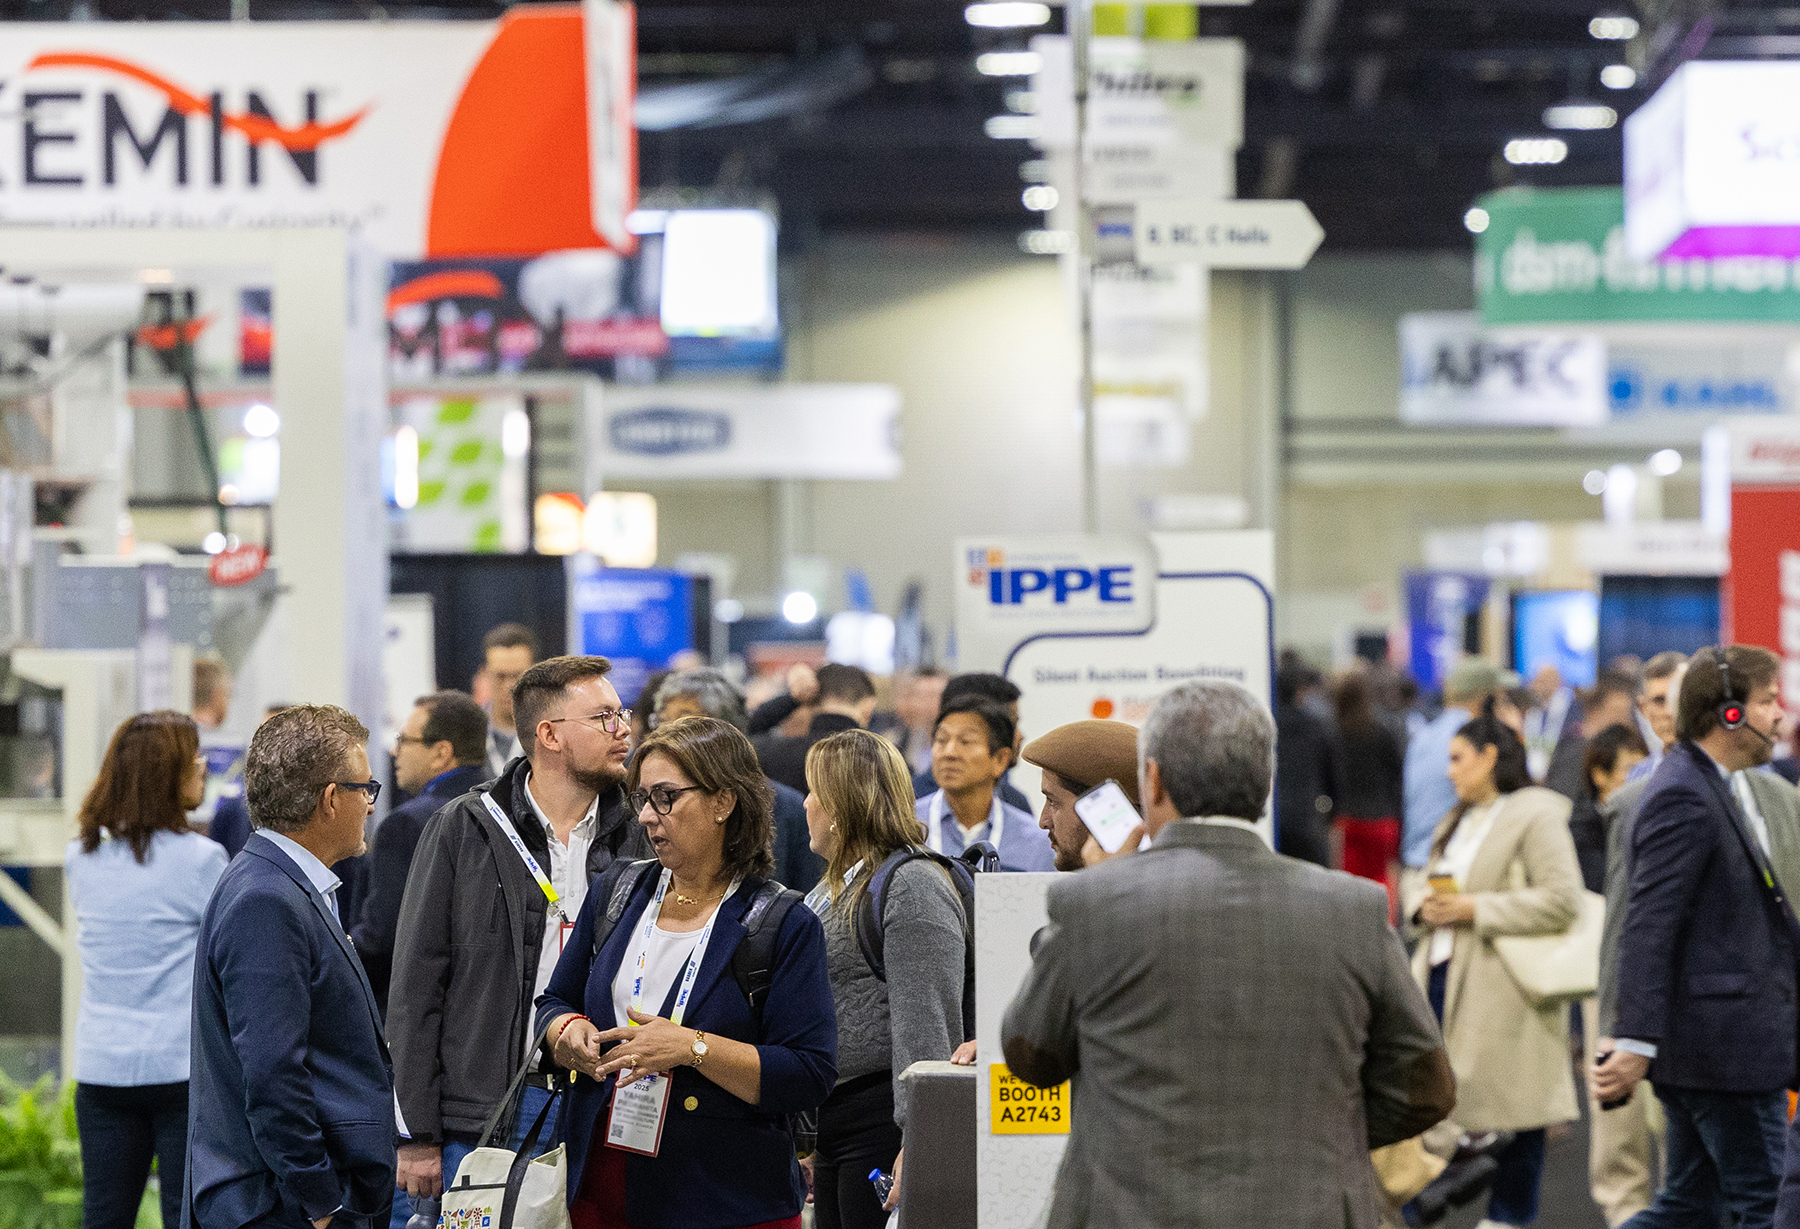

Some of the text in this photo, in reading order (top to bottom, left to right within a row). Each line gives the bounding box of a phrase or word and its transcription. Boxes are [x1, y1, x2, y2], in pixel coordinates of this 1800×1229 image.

[0, 86, 320, 187] EMIN
[988, 566, 1135, 605] IPPE
[634, 1083, 650, 1091] 2025
[1000, 1086, 1060, 1101] BOOTH
[1001, 1106, 1060, 1122] A2743
